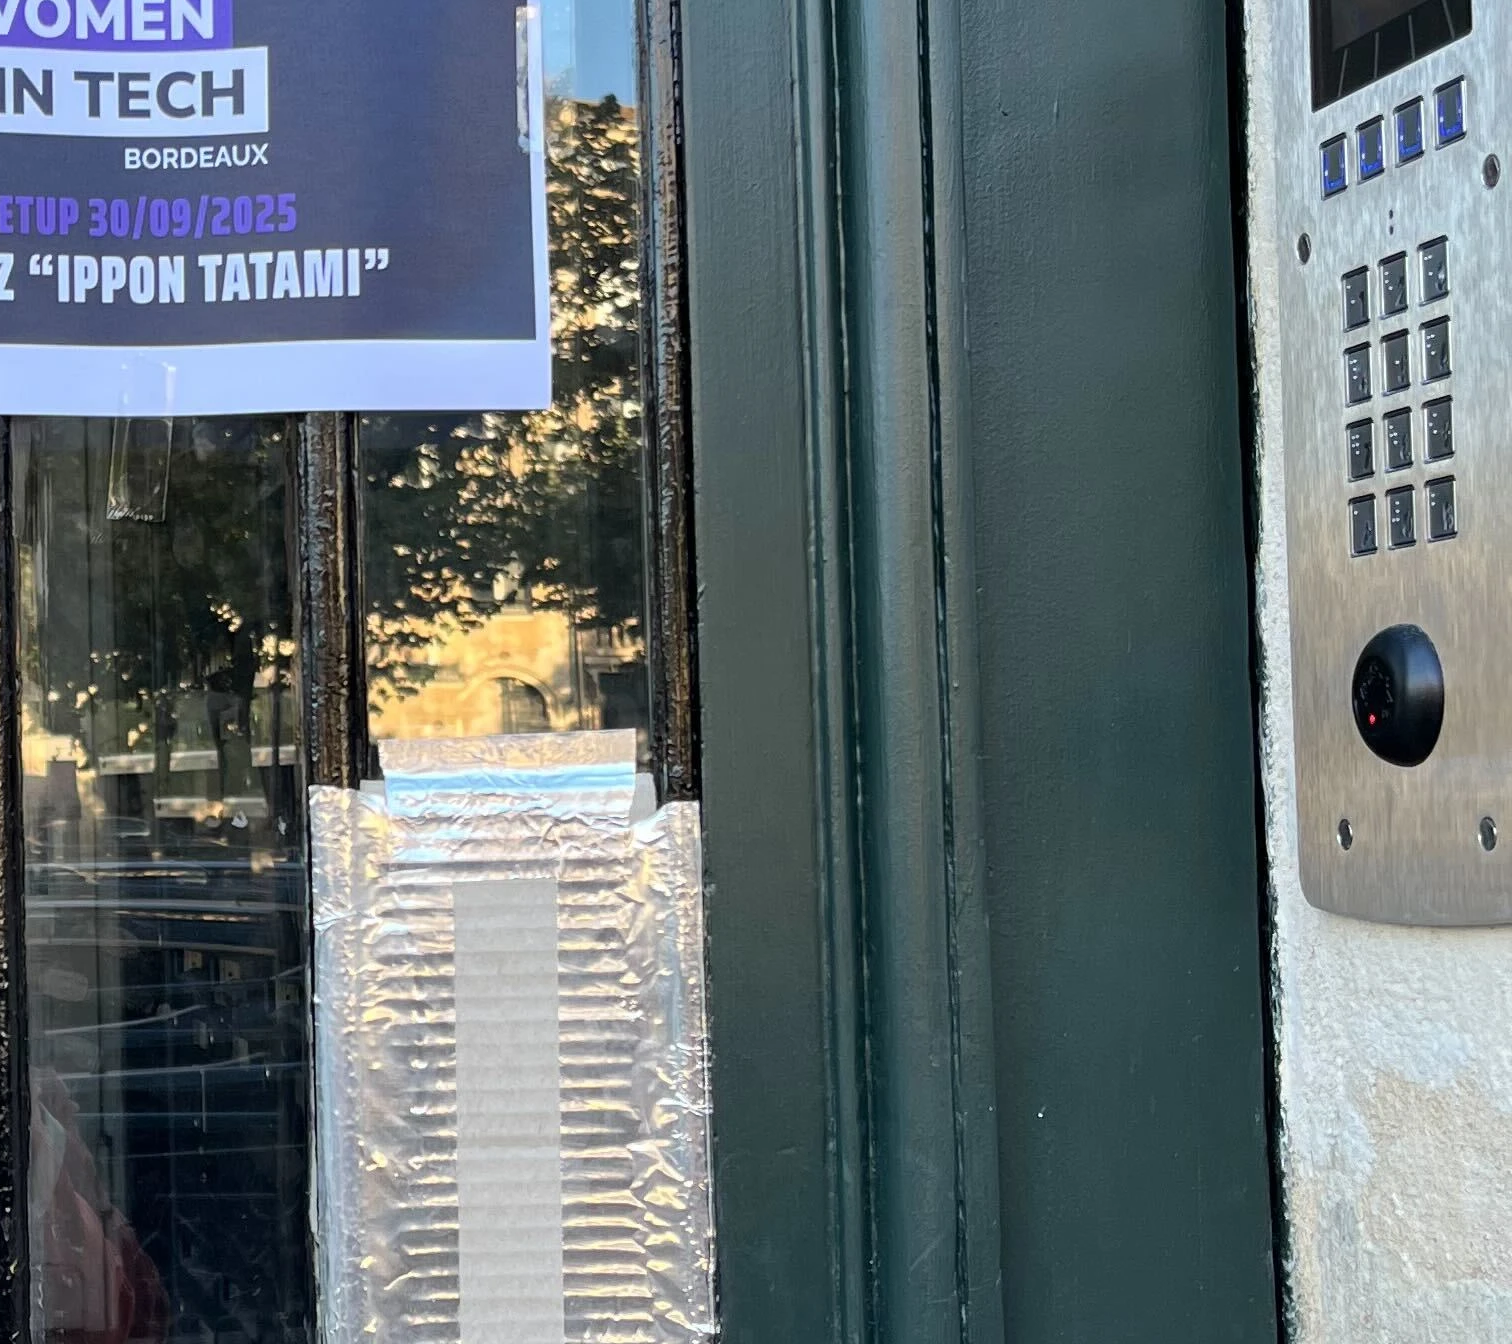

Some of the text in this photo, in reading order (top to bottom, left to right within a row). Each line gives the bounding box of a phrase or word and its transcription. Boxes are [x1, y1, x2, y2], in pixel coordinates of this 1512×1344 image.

[74, 68, 247, 120] TECH
[124, 142, 270, 171] BORDEAUX
[88, 193, 298, 241] 30/09/2025
[29, 253, 186, 305] “IPPON
[197, 247, 391, 304] TATAMI”
